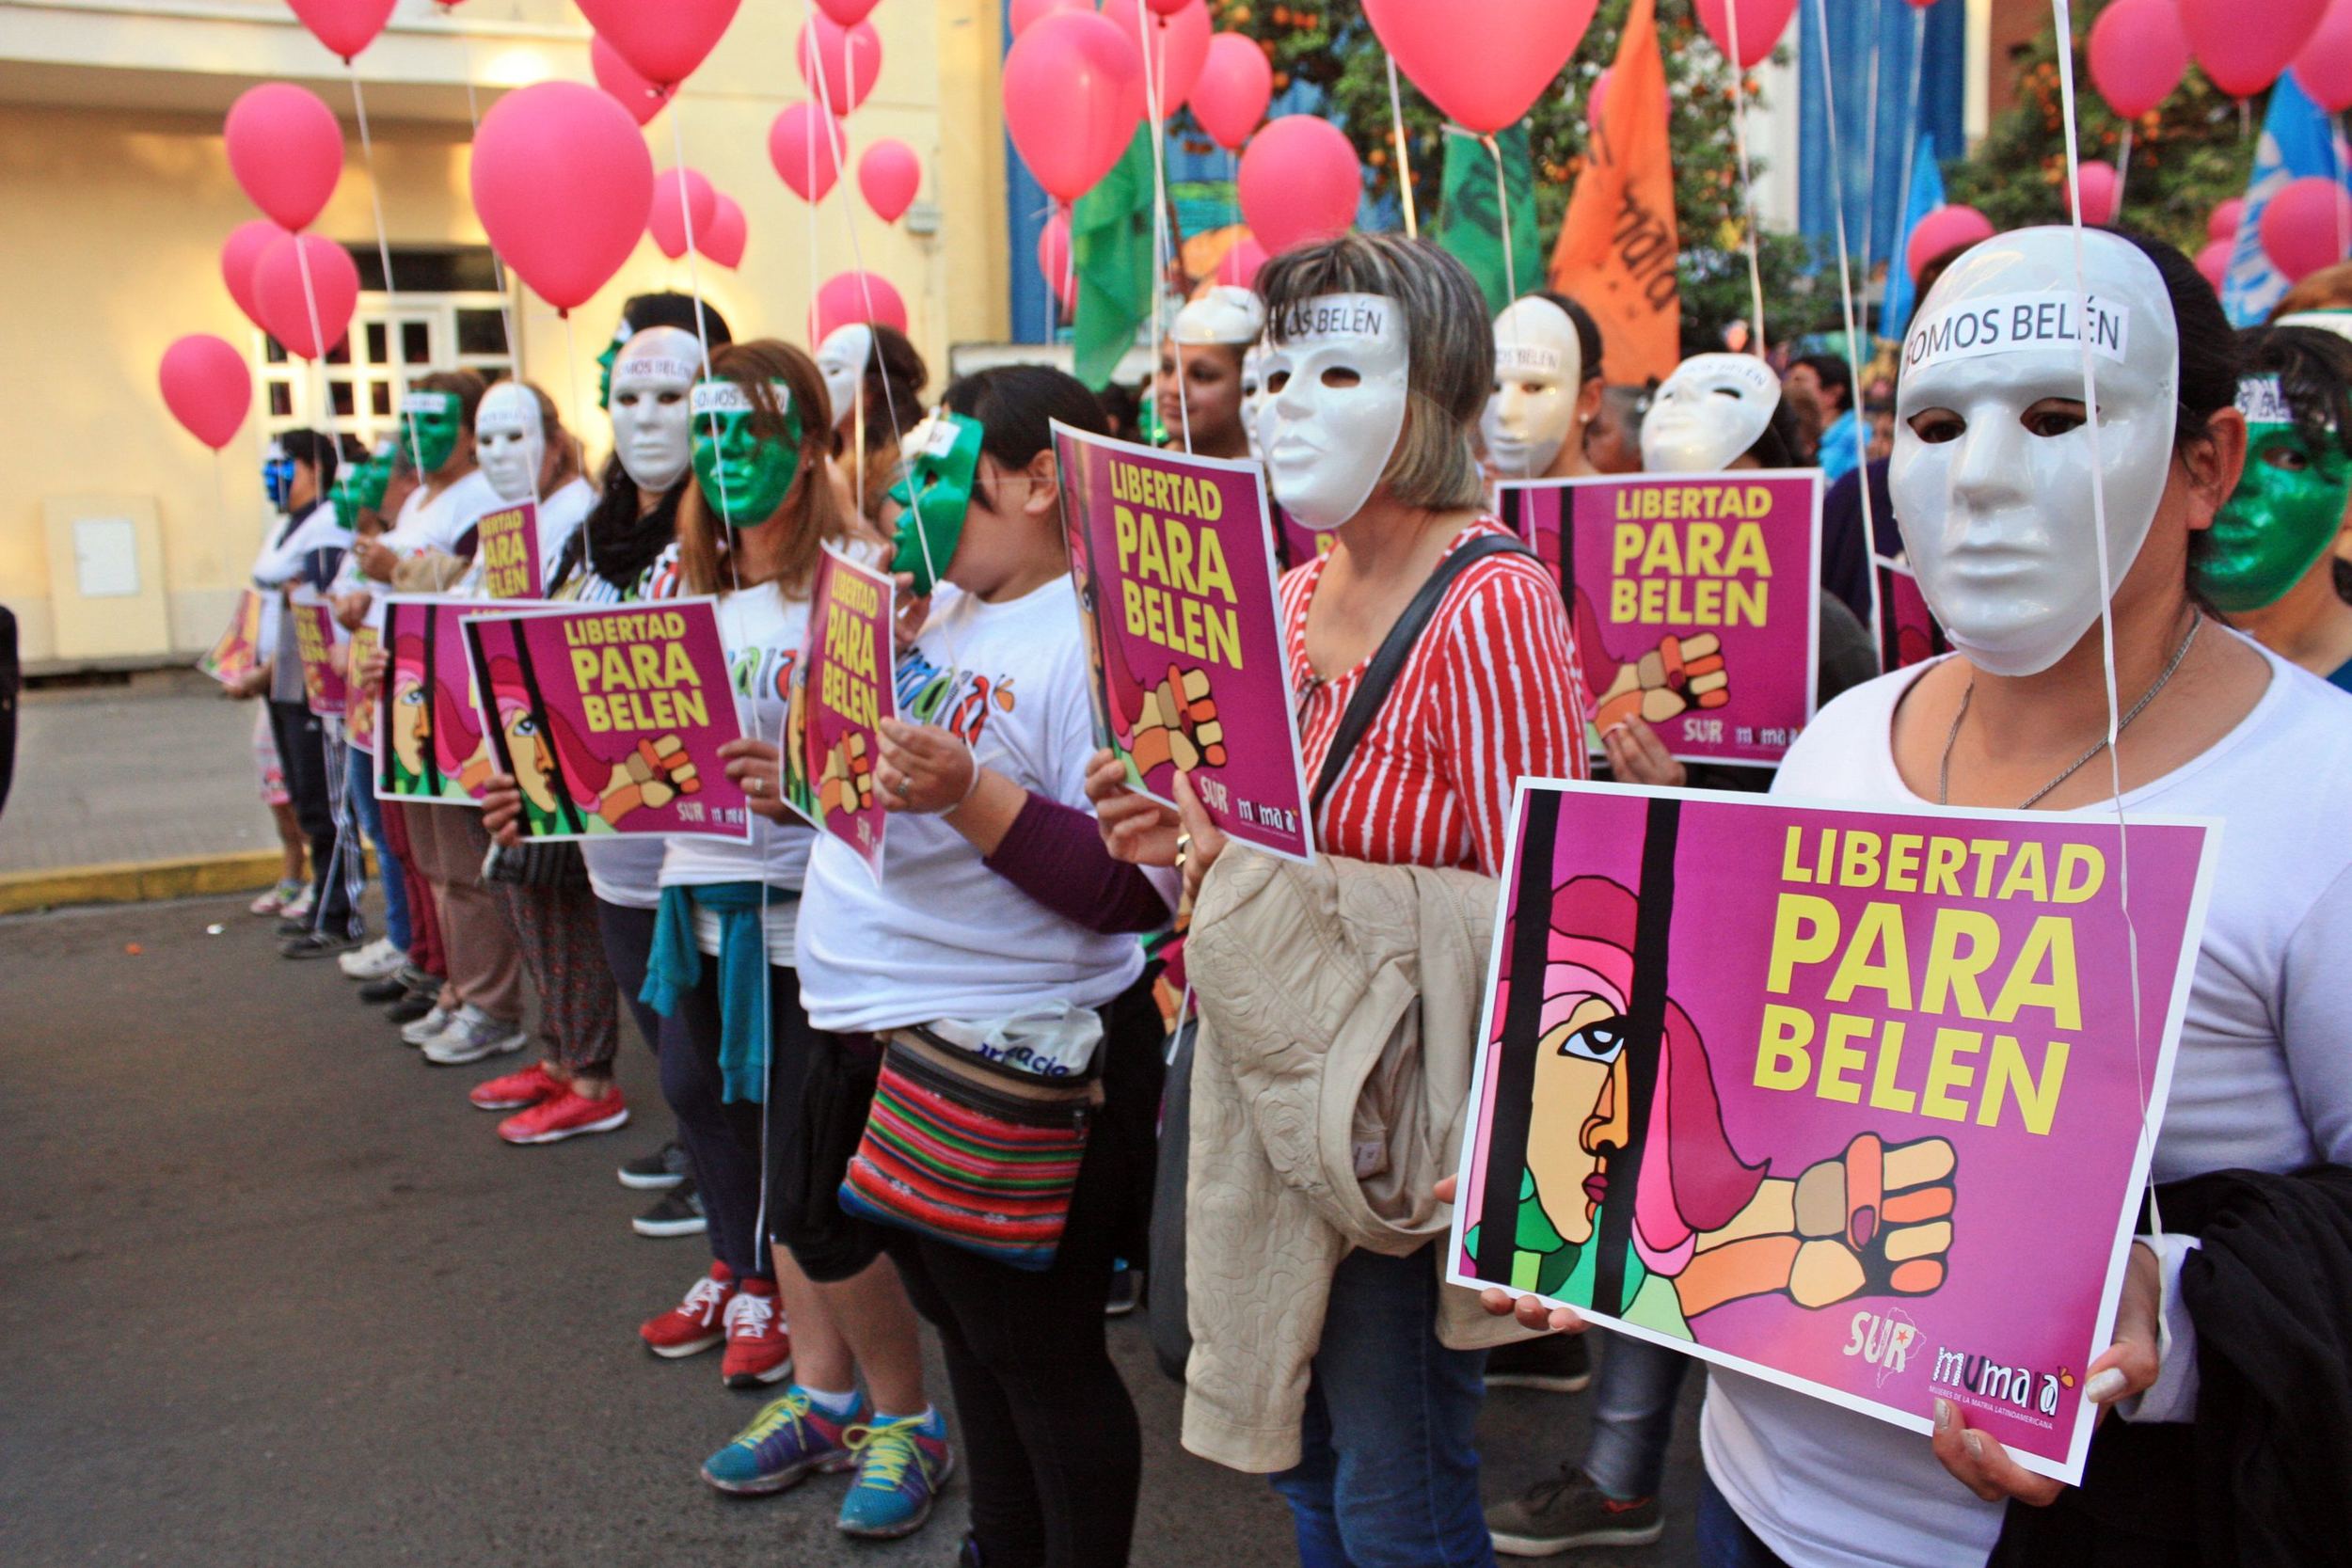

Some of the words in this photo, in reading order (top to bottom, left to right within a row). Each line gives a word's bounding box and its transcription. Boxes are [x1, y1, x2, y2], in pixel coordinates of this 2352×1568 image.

[1317, 301, 1382, 335] BELÉN
[1108, 460, 1223, 522] LIBERTAD
[1616, 486, 1773, 520] LIBERTAD
[485, 531, 528, 568] ARA
[1113, 504, 1238, 604] PARA
[1613, 521, 1773, 578] PARA
[487, 565, 530, 598] ELEN
[831, 567, 880, 620] LIBERTAD
[1610, 578, 1769, 628] BELEN
[564, 611, 687, 647] LIBERTAD
[823, 602, 880, 684] PARA
[1122, 578, 1244, 671] BELEN
[569, 641, 702, 694] PARA
[581, 689, 710, 733] BELEN
[821, 660, 881, 734] BELEN
[1683, 718, 1724, 744] SUR
[676, 801, 705, 822] SUR
[1200, 775, 1230, 815] SUR
[1780, 826, 2106, 905] LIBERTAD
[1766, 894, 2083, 1032] PARA
[1752, 1004, 2071, 1136] BELEN
[1842, 1310, 1917, 1373] SUR
[1953, 1393, 1963, 1402] DE
[1963, 1395, 1971, 1404] LA
